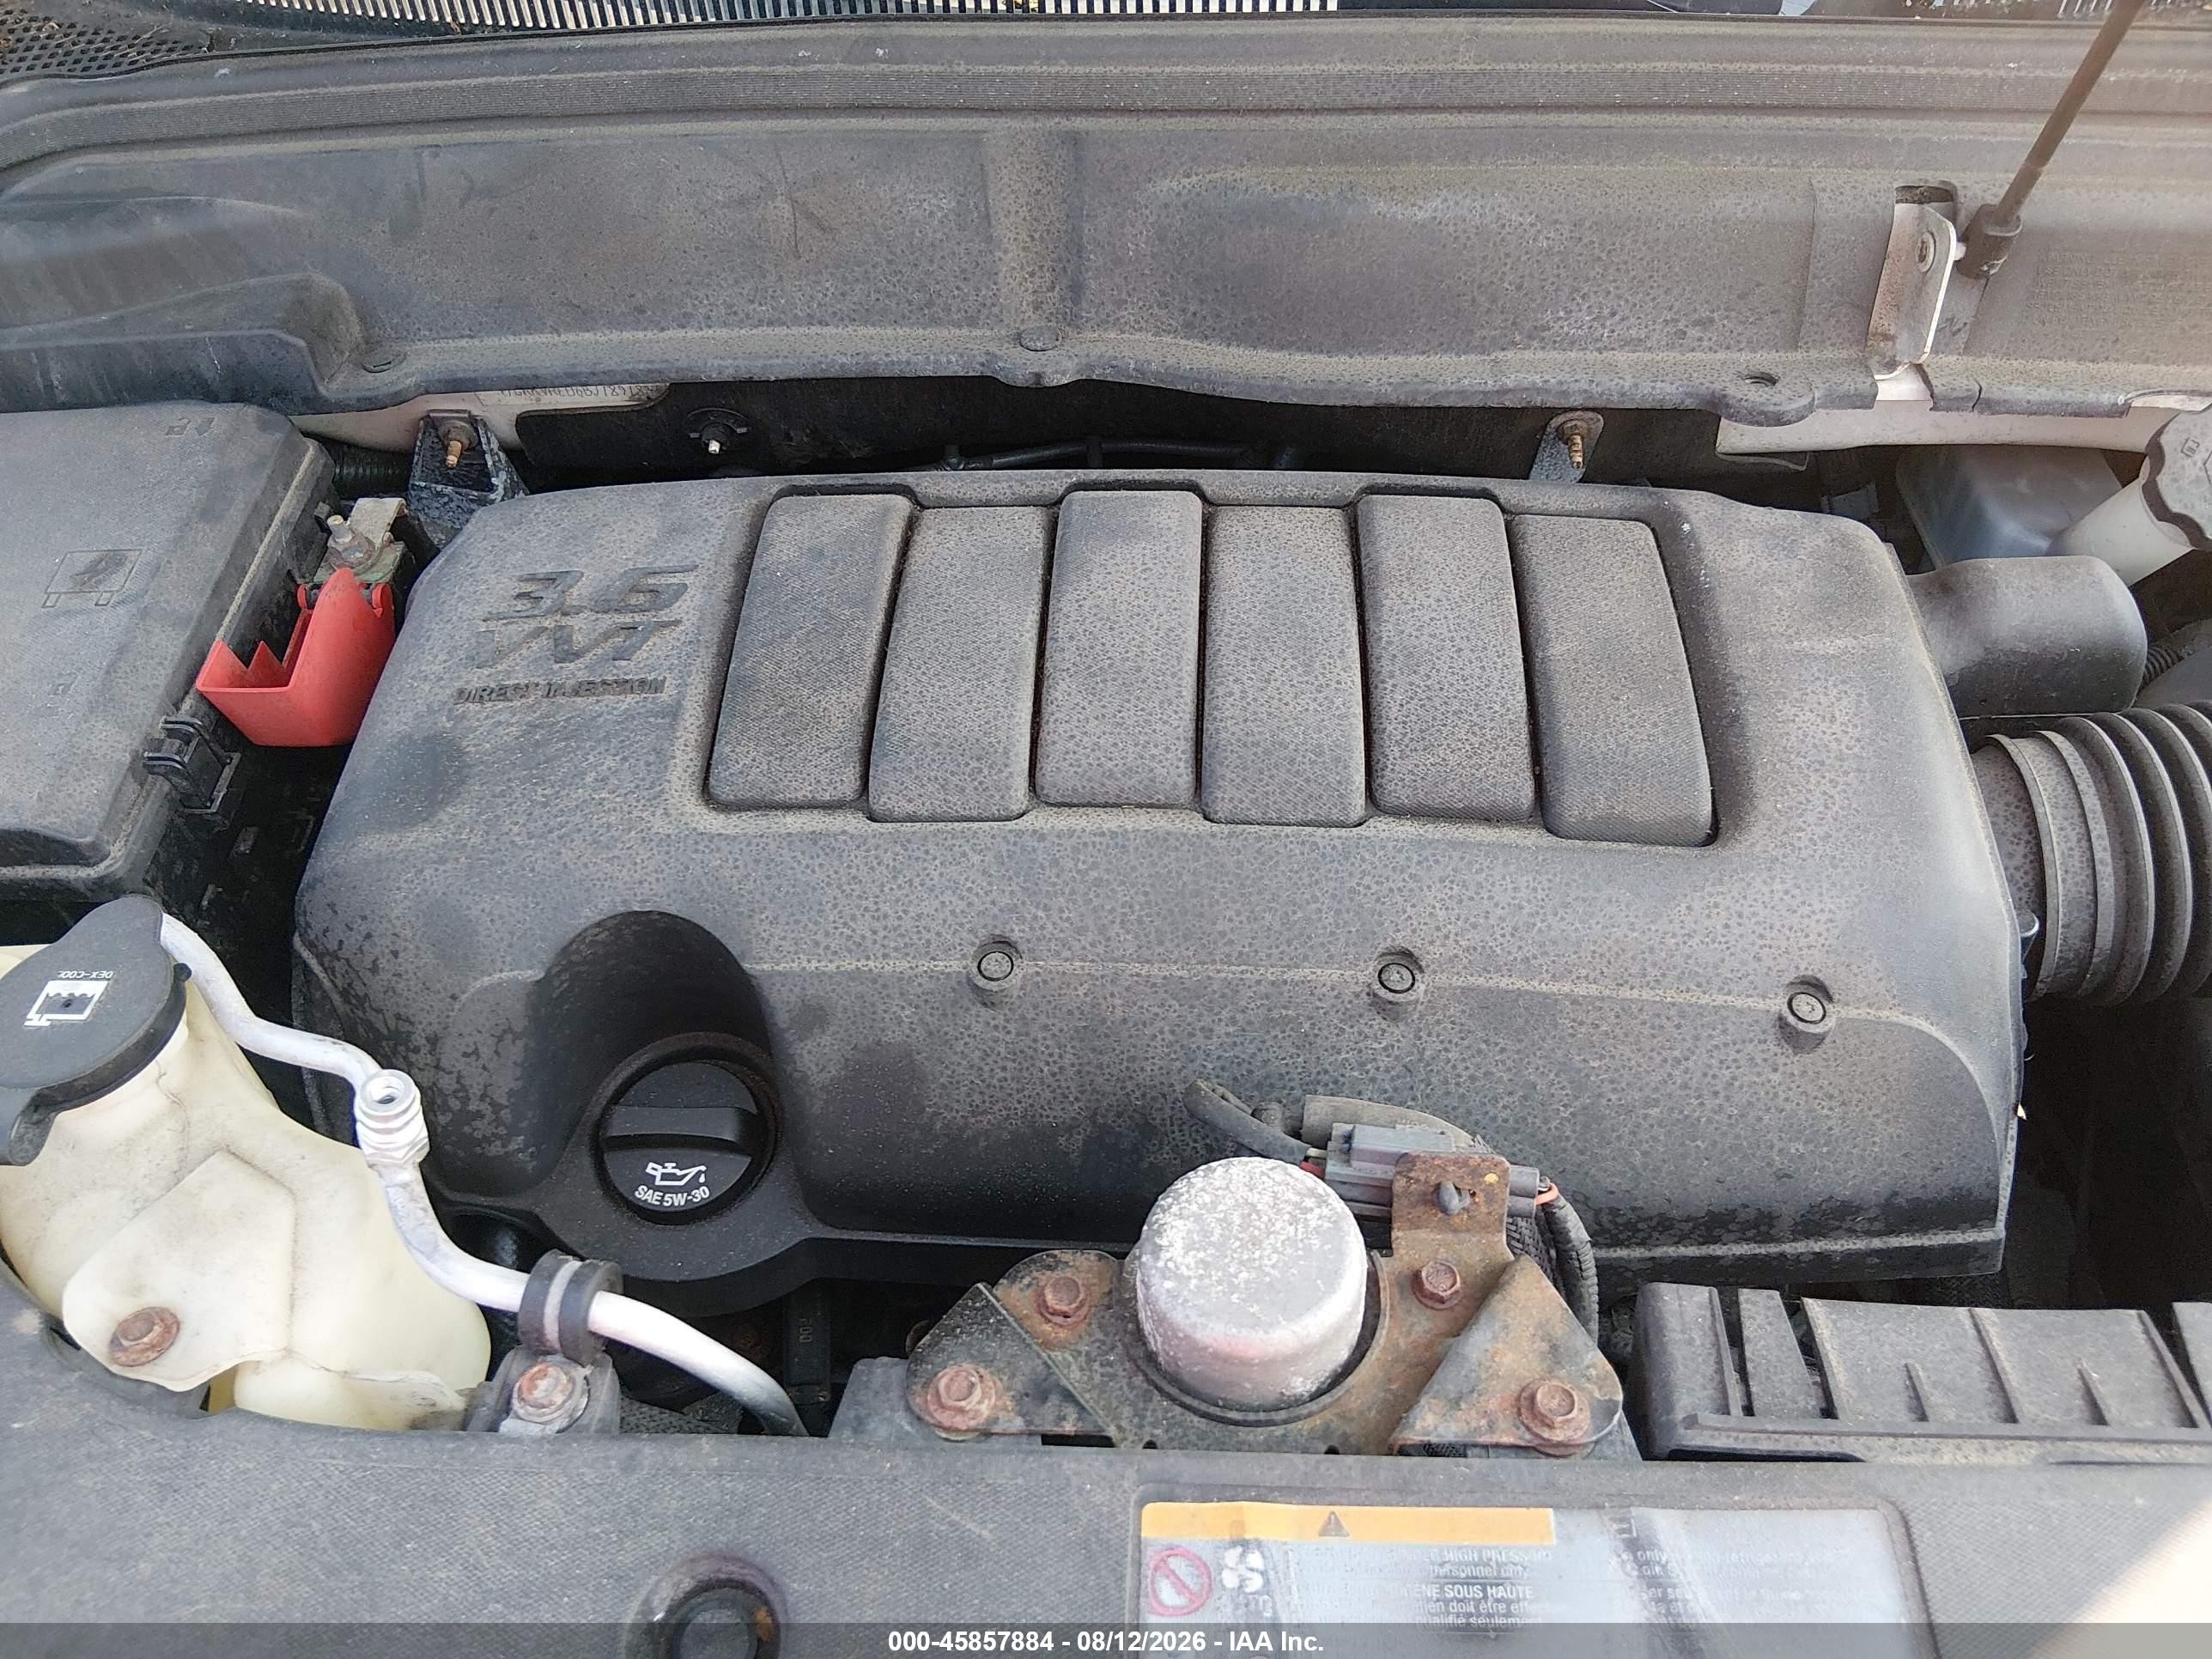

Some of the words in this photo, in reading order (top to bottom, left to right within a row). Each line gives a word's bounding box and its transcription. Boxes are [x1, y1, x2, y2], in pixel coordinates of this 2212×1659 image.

[635, 1185, 664, 1205] SAE
[663, 1186, 709, 1206] 5W-30
[1444, 1584, 1484, 1599] SOUS
[1487, 1584, 1534, 1599] HAUTE
[1449, 1600, 1476, 1613] doit
